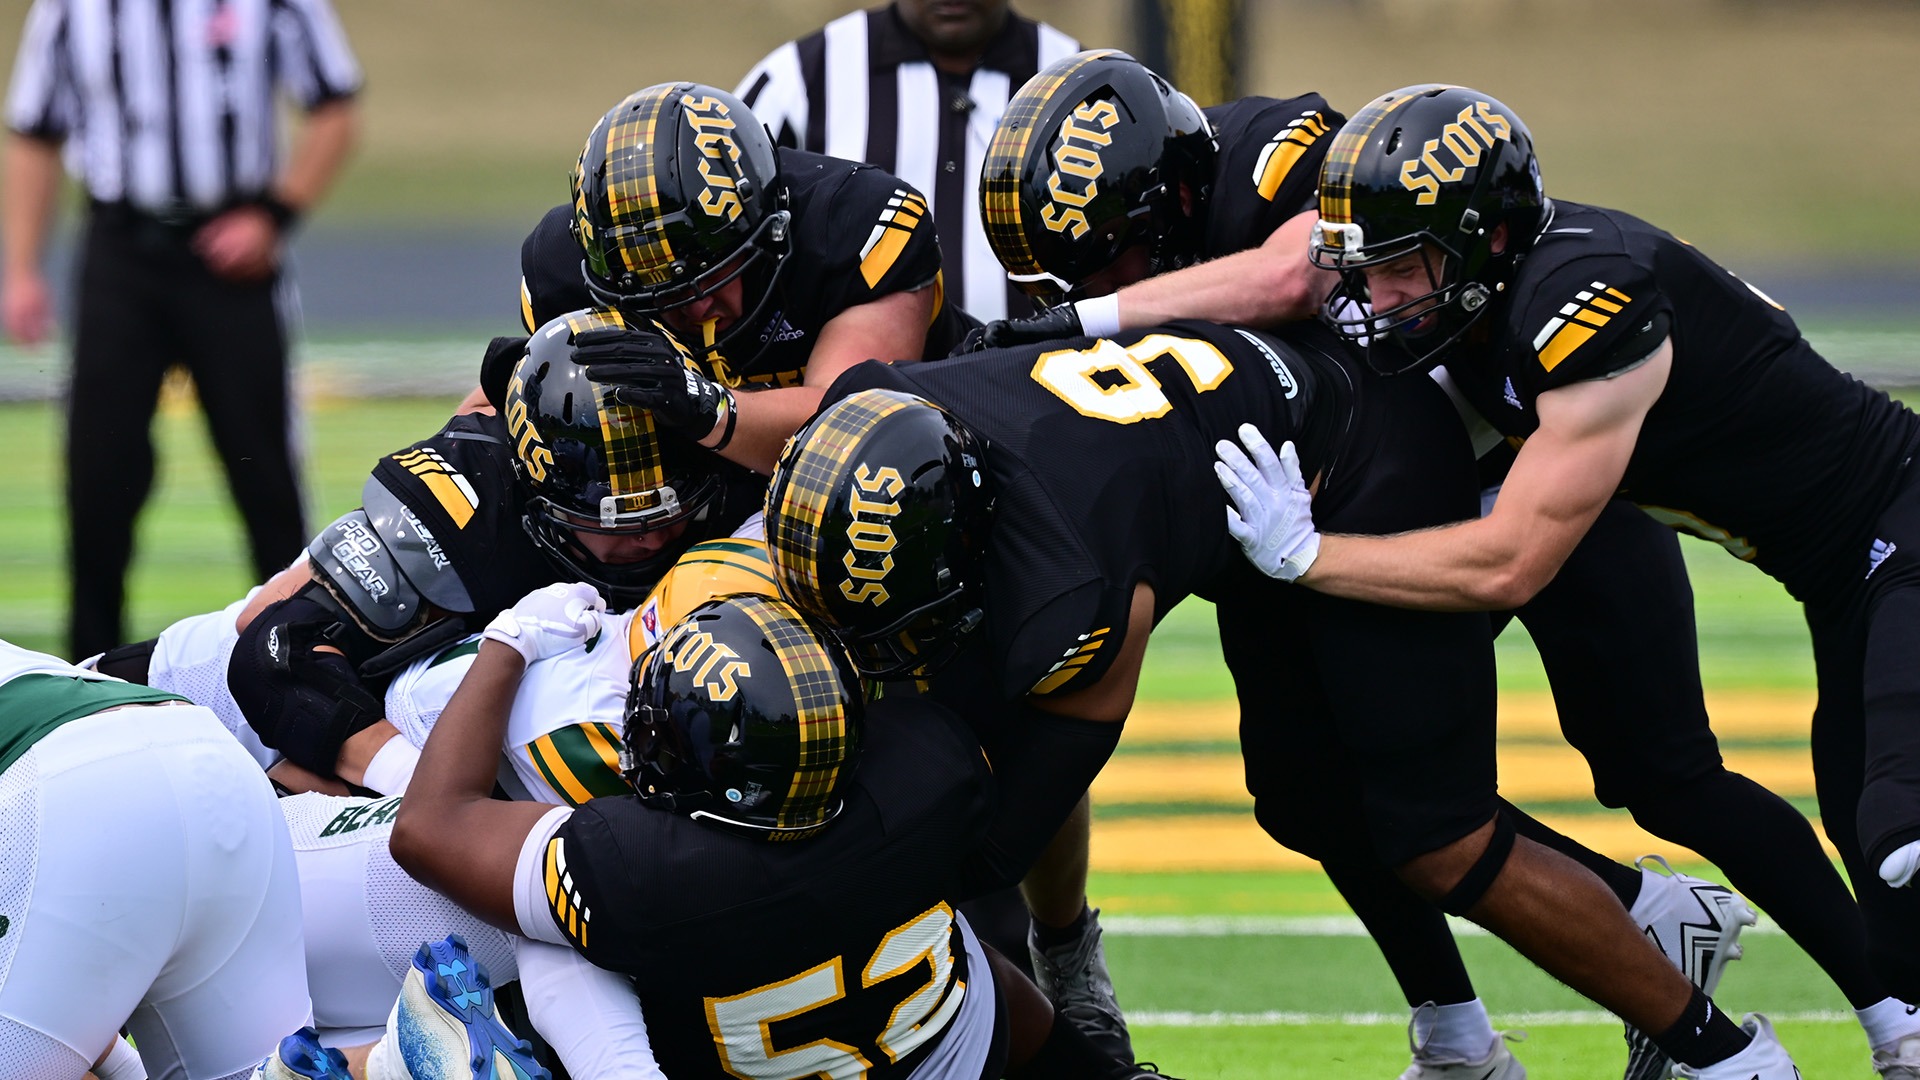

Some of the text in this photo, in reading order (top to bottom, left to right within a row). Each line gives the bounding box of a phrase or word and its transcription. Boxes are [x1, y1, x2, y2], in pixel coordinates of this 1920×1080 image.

[680, 94, 744, 222] SCOTS
[1040, 99, 1120, 240] SCOTS
[1398, 101, 1512, 206] SCOTS
[760, 329, 805, 343] aidas
[332, 539, 389, 603] GEAR
[335, 519, 380, 556] PRO
[838, 462, 906, 607] SCOTS
[318, 797, 404, 837] BEA
[703, 899, 967, 1080] 52
